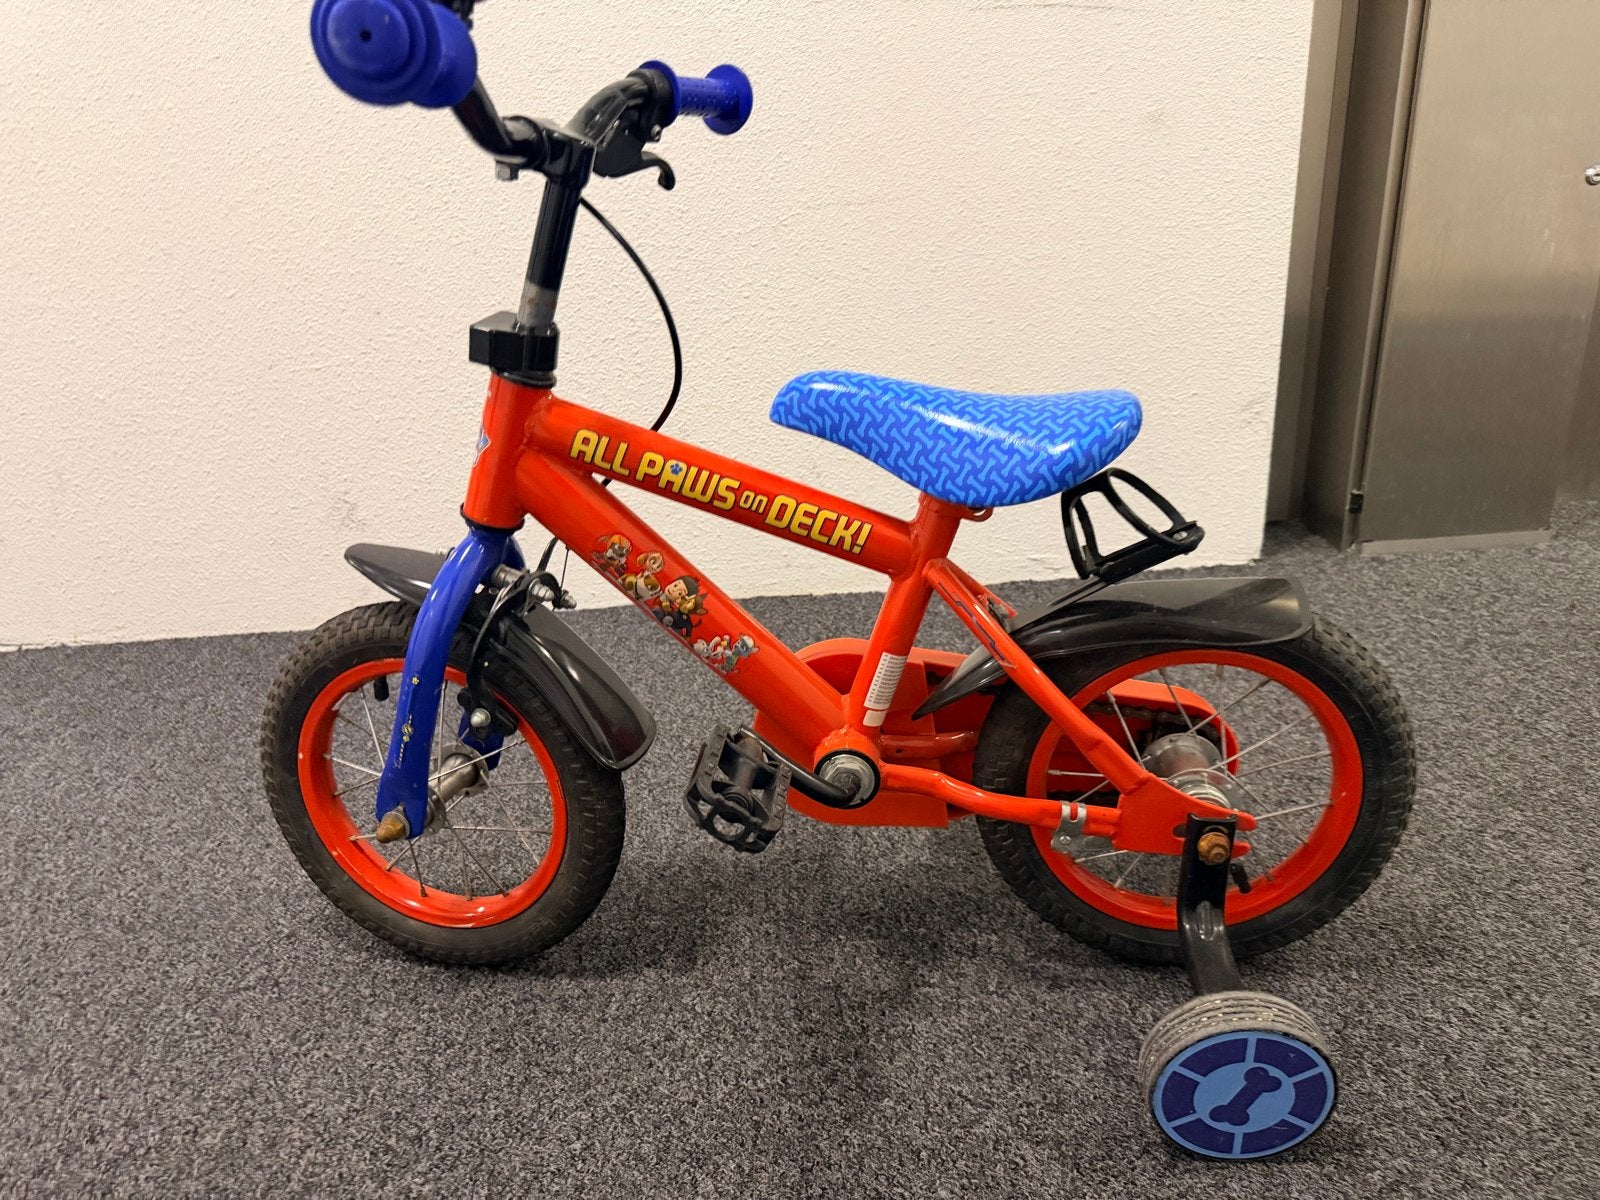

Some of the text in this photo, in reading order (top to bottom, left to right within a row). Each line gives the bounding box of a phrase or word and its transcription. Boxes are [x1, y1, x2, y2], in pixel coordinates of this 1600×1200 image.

[570, 429, 872, 554] ALL PAWS on DECK!
